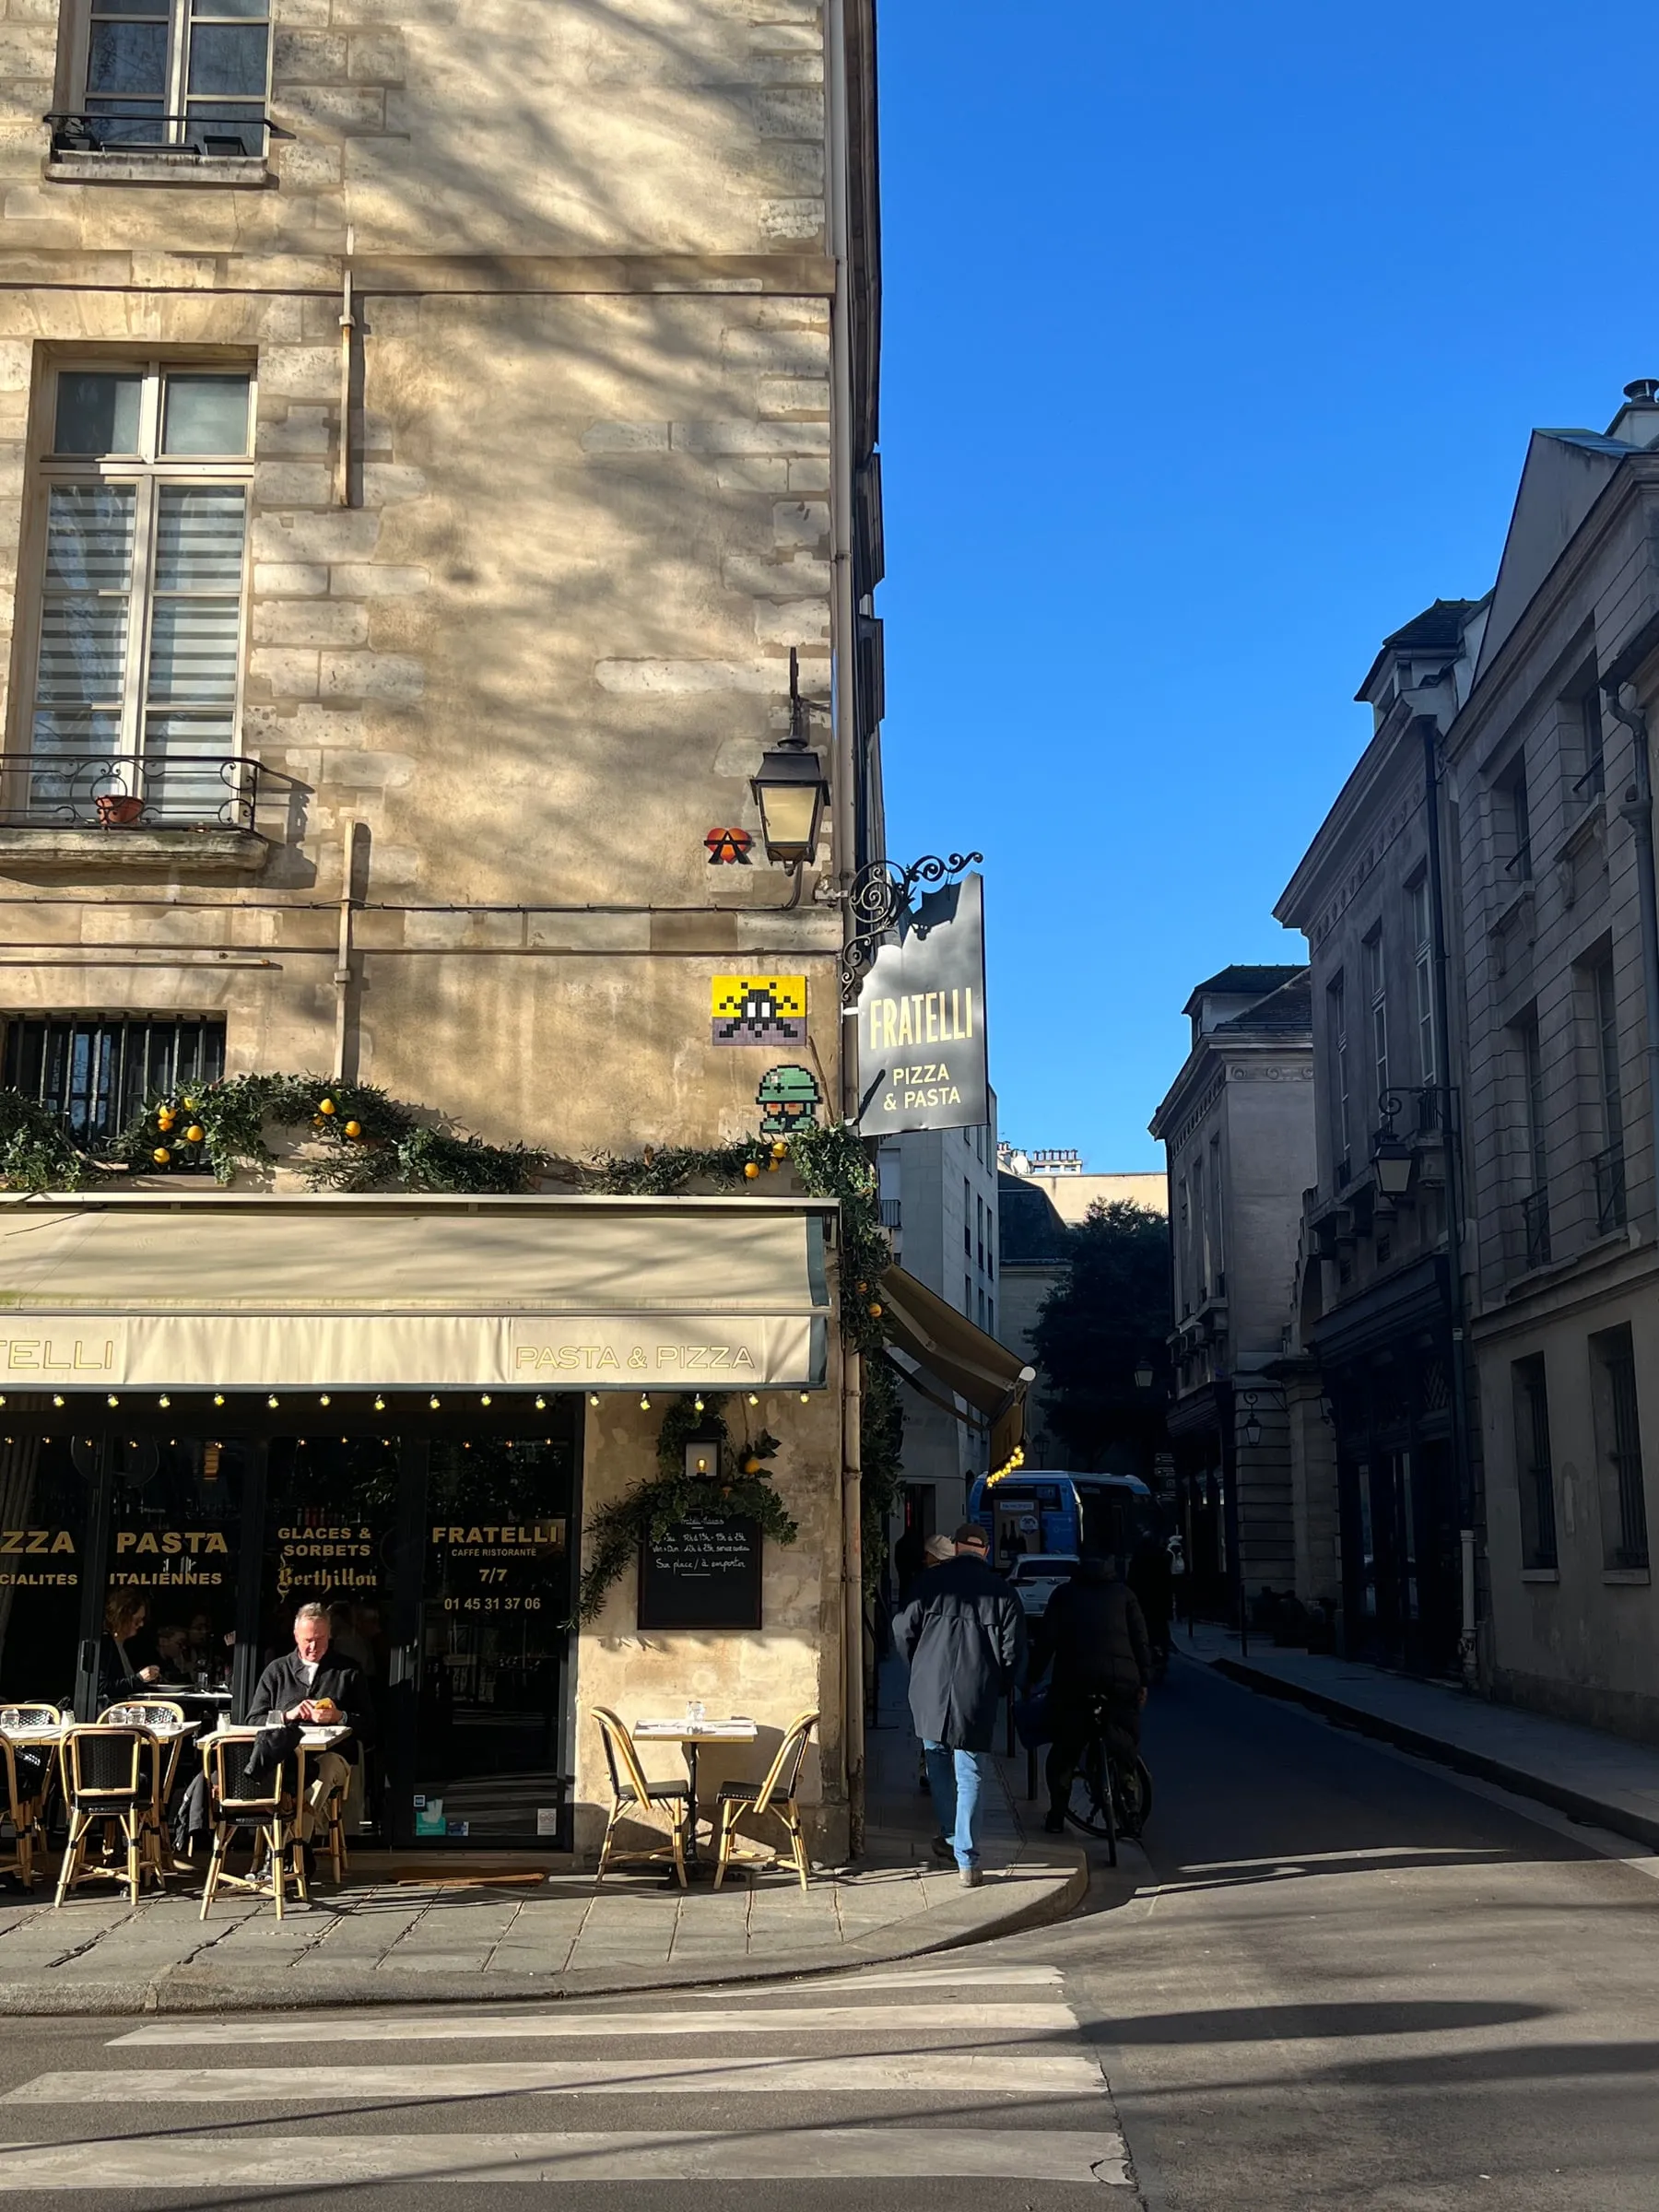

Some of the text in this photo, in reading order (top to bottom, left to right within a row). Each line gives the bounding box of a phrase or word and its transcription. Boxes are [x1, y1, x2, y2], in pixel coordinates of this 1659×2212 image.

[870, 987, 973, 1050] FRATELLI
[892, 1063, 950, 1087] PIZZA
[883, 1086, 961, 1112] & PASTA
[0, 1339, 113, 1370] ELLI
[515, 1346, 756, 1371] PASTA & PIZZA
[0, 1530, 76, 1554] ZZA
[115, 1530, 229, 1555] PASTA
[277, 1526, 371, 1540] GLACES &
[431, 1525, 558, 1544] FRATELLI
[283, 1544, 371, 1557] SORBETS
[482, 1547, 537, 1558] RISTORANTE
[109, 1571, 223, 1586] ITALIENNES
[276, 1556, 378, 1601] Berthillon
[478, 1567, 508, 1584] 7/7
[444, 1597, 542, 1610] 01 45 31 37 06
